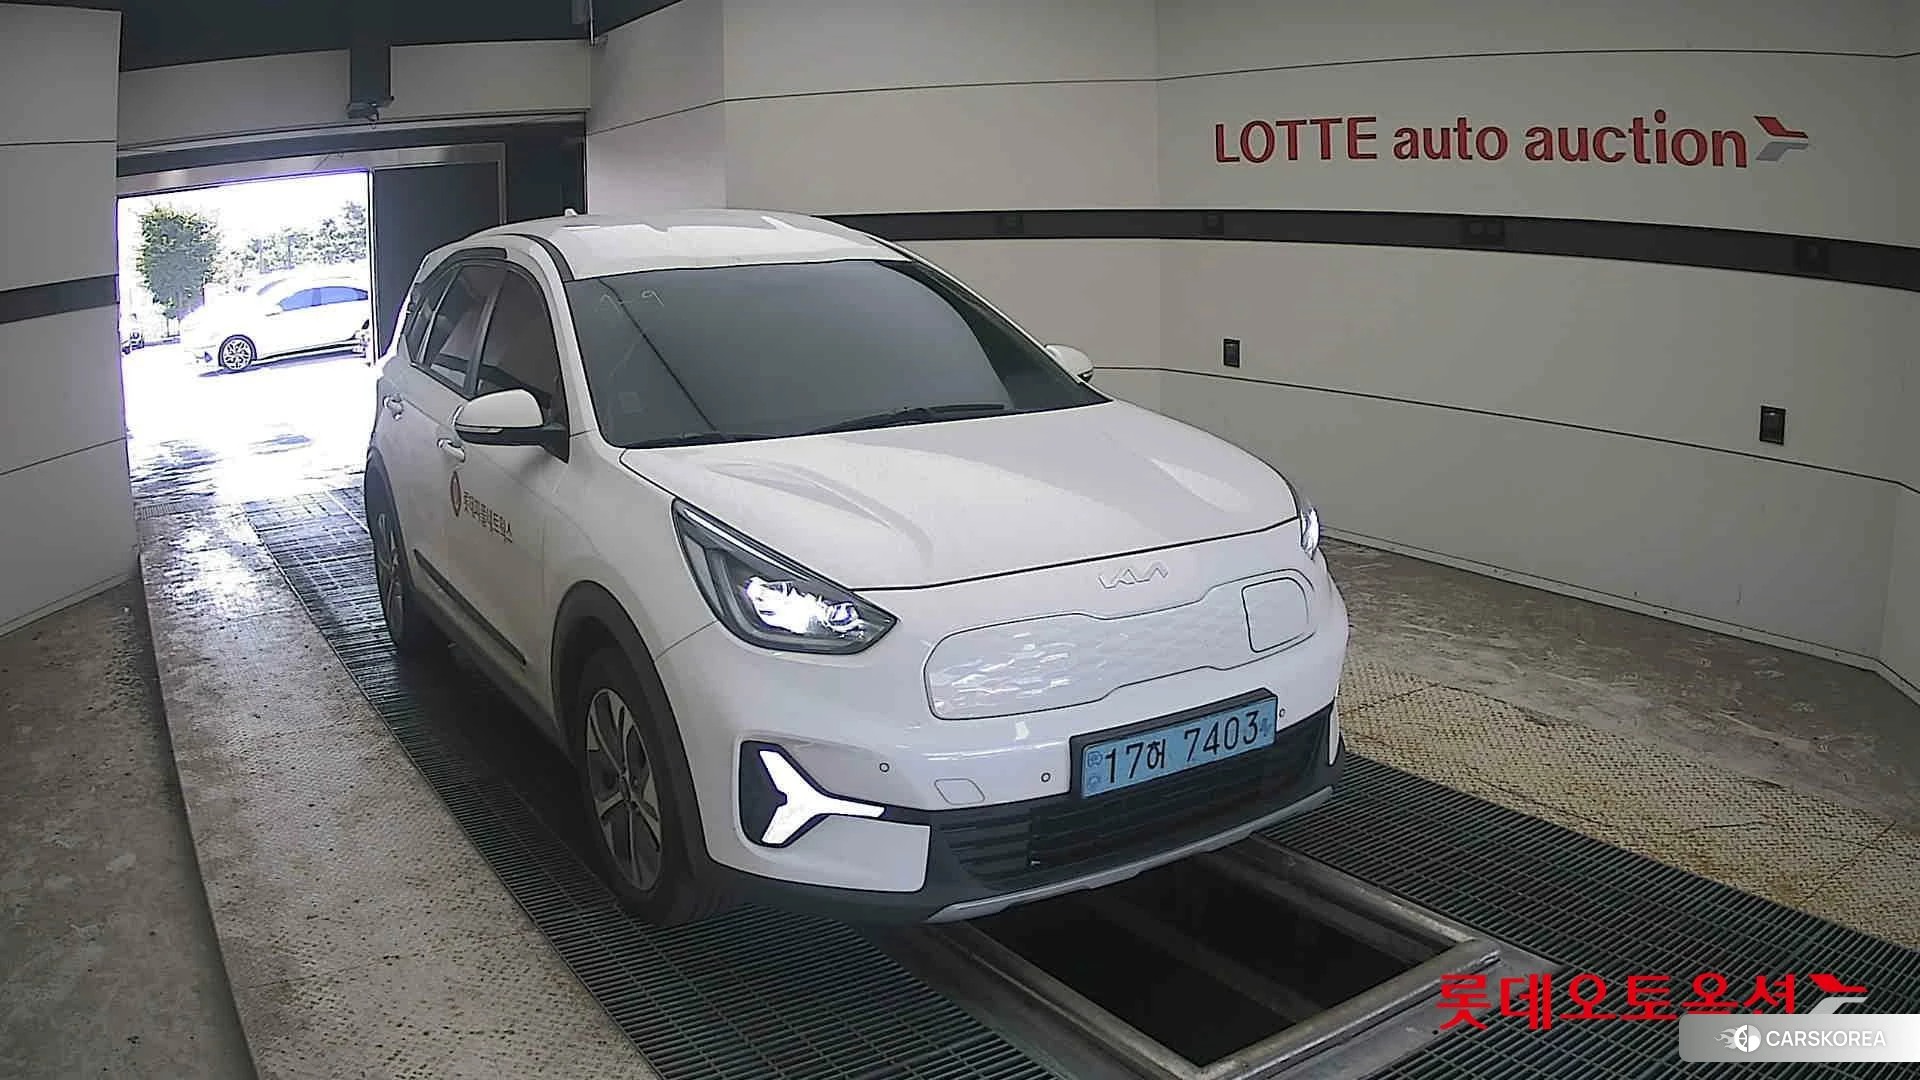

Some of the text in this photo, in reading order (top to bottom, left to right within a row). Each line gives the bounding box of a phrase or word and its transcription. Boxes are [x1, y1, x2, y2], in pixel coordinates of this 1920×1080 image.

[1215, 110, 1748, 169] LOTTE auto auction
[1104, 710, 1261, 784] 17허 7403
